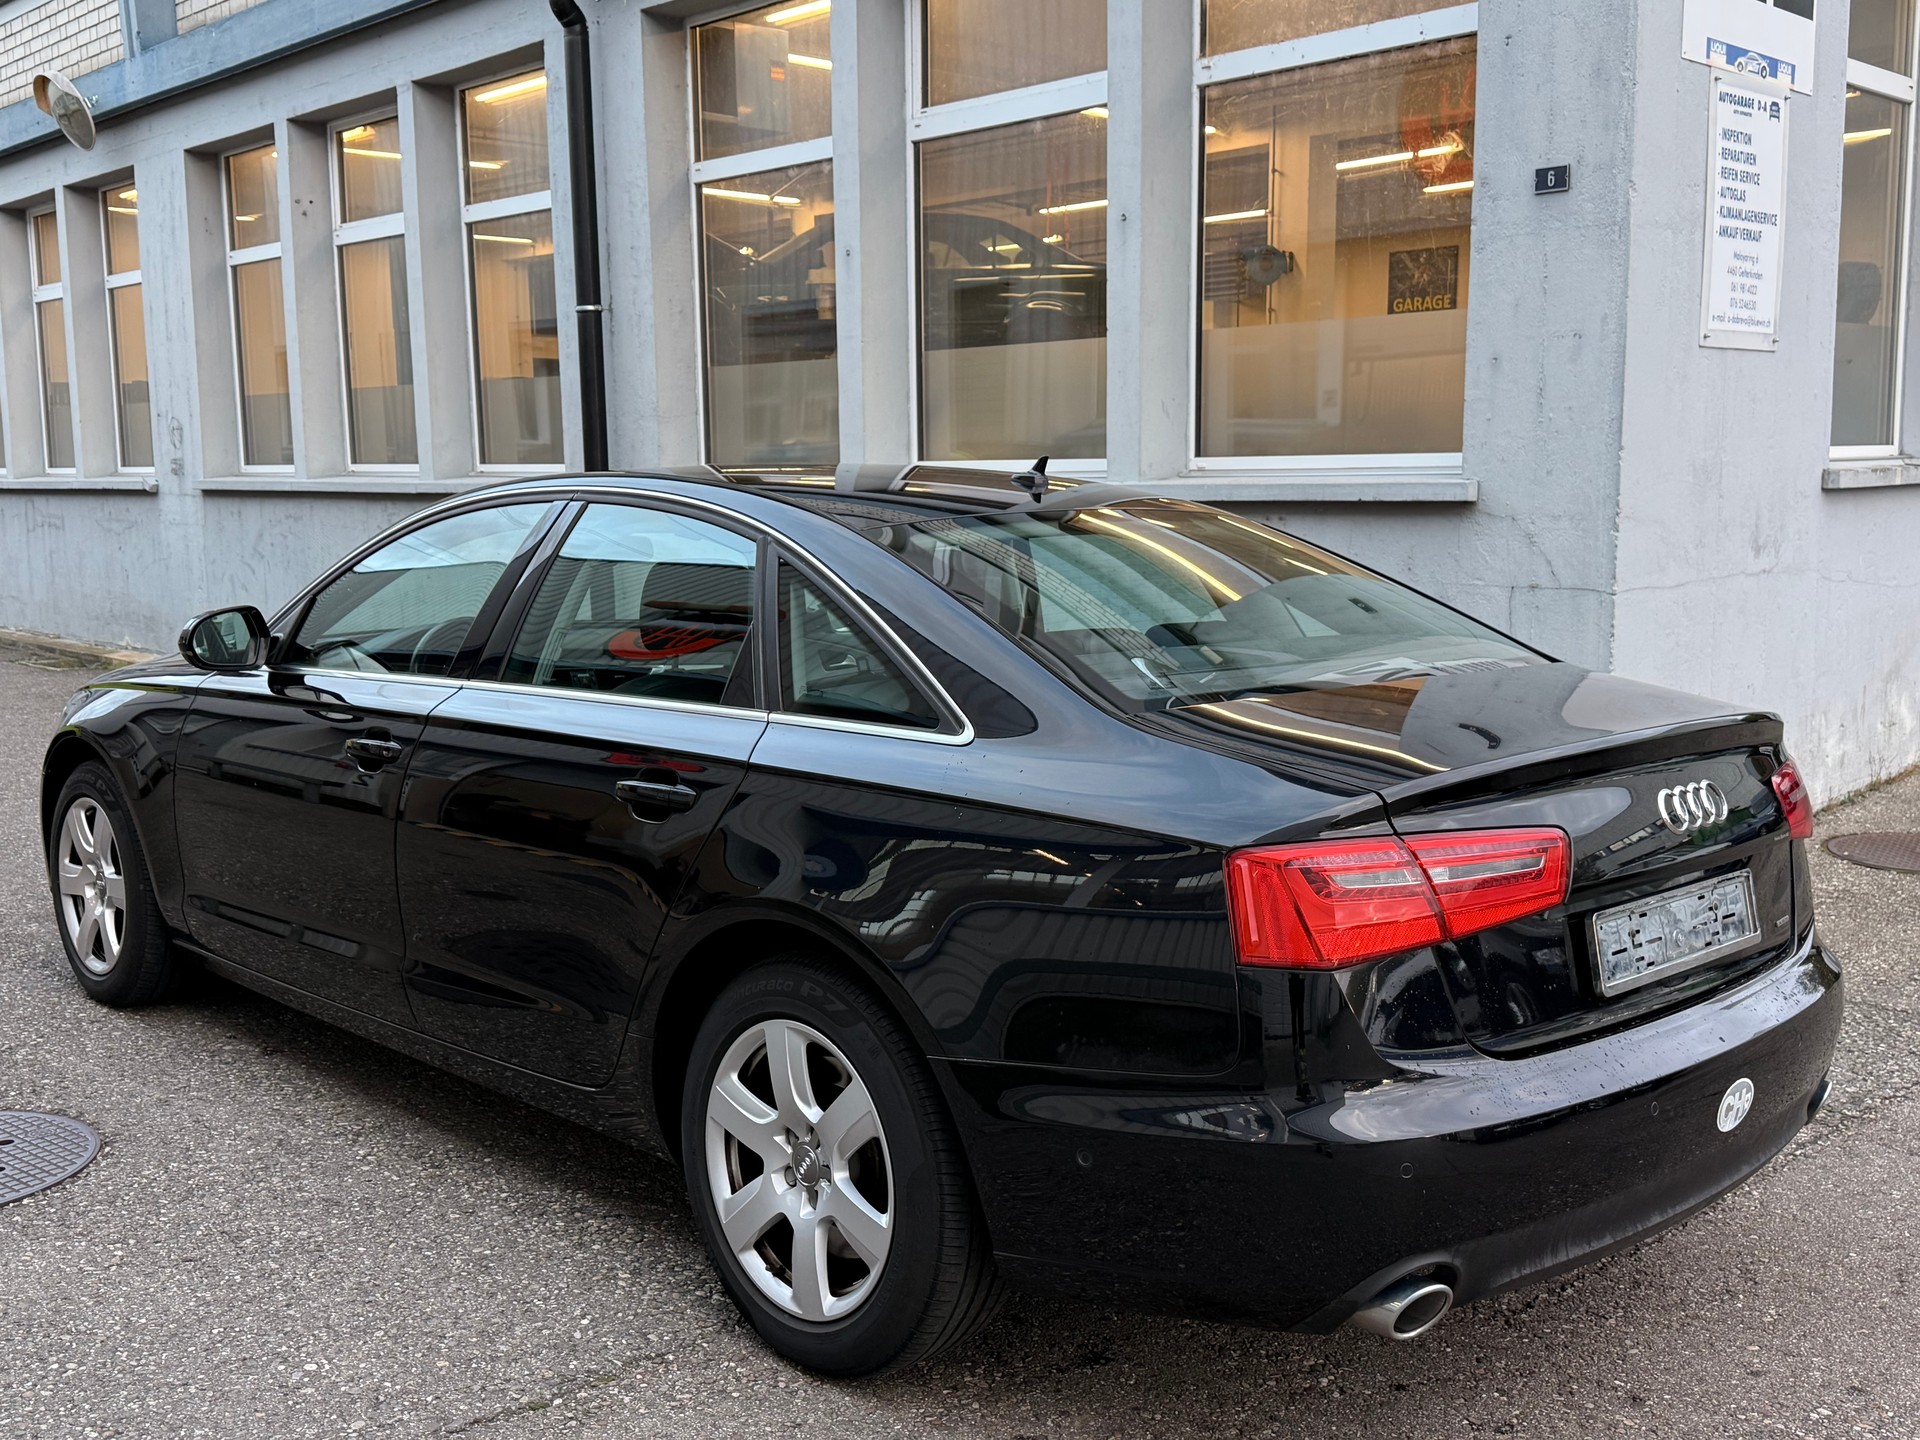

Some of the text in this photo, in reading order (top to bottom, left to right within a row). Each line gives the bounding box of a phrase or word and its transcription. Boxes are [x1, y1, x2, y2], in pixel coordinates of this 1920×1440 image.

[1719, 91, 1768, 112] AUTOGARAGE D-A
[1722, 127, 1752, 146] INSPEKTION
[1721, 146, 1757, 166] REPARATUREN
[1547, 170, 1555, 187] 6
[1720, 166, 1761, 186] REIFEN SERVICE
[1720, 186, 1746, 203] AUTOGLAS
[1719, 205, 1778, 227] KLIMAANLAGENSERVICE
[1719, 224, 1763, 243] ANKAUF VERKAUF
[1393, 294, 1452, 312] GARAGE
[799, 980, 850, 1012] P7
